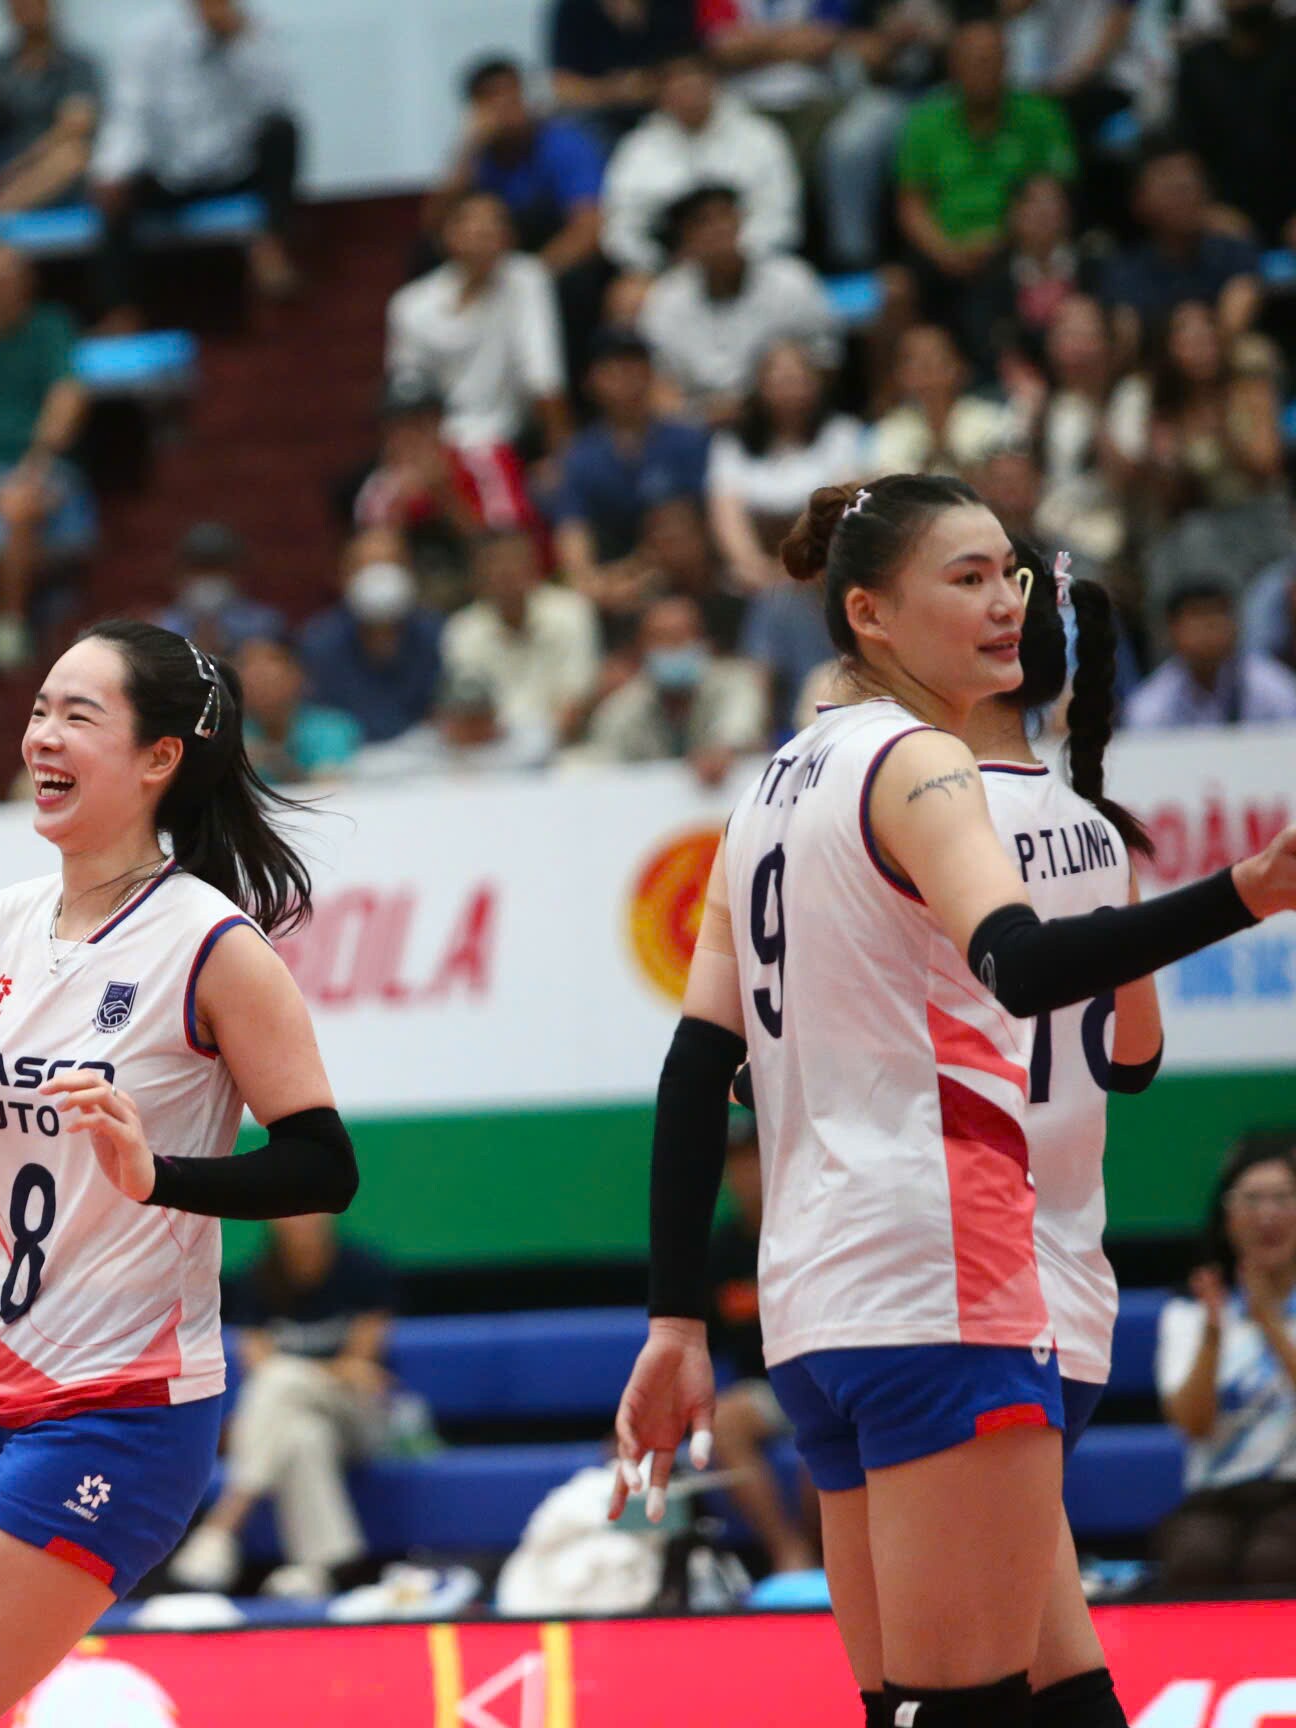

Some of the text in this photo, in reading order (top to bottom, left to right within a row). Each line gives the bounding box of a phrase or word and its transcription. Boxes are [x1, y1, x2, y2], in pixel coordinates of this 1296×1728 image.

[1014, 819, 1117, 882] P.T.LINH
[751, 843, 786, 1039] 9
[0, 1163, 56, 1325] 8
